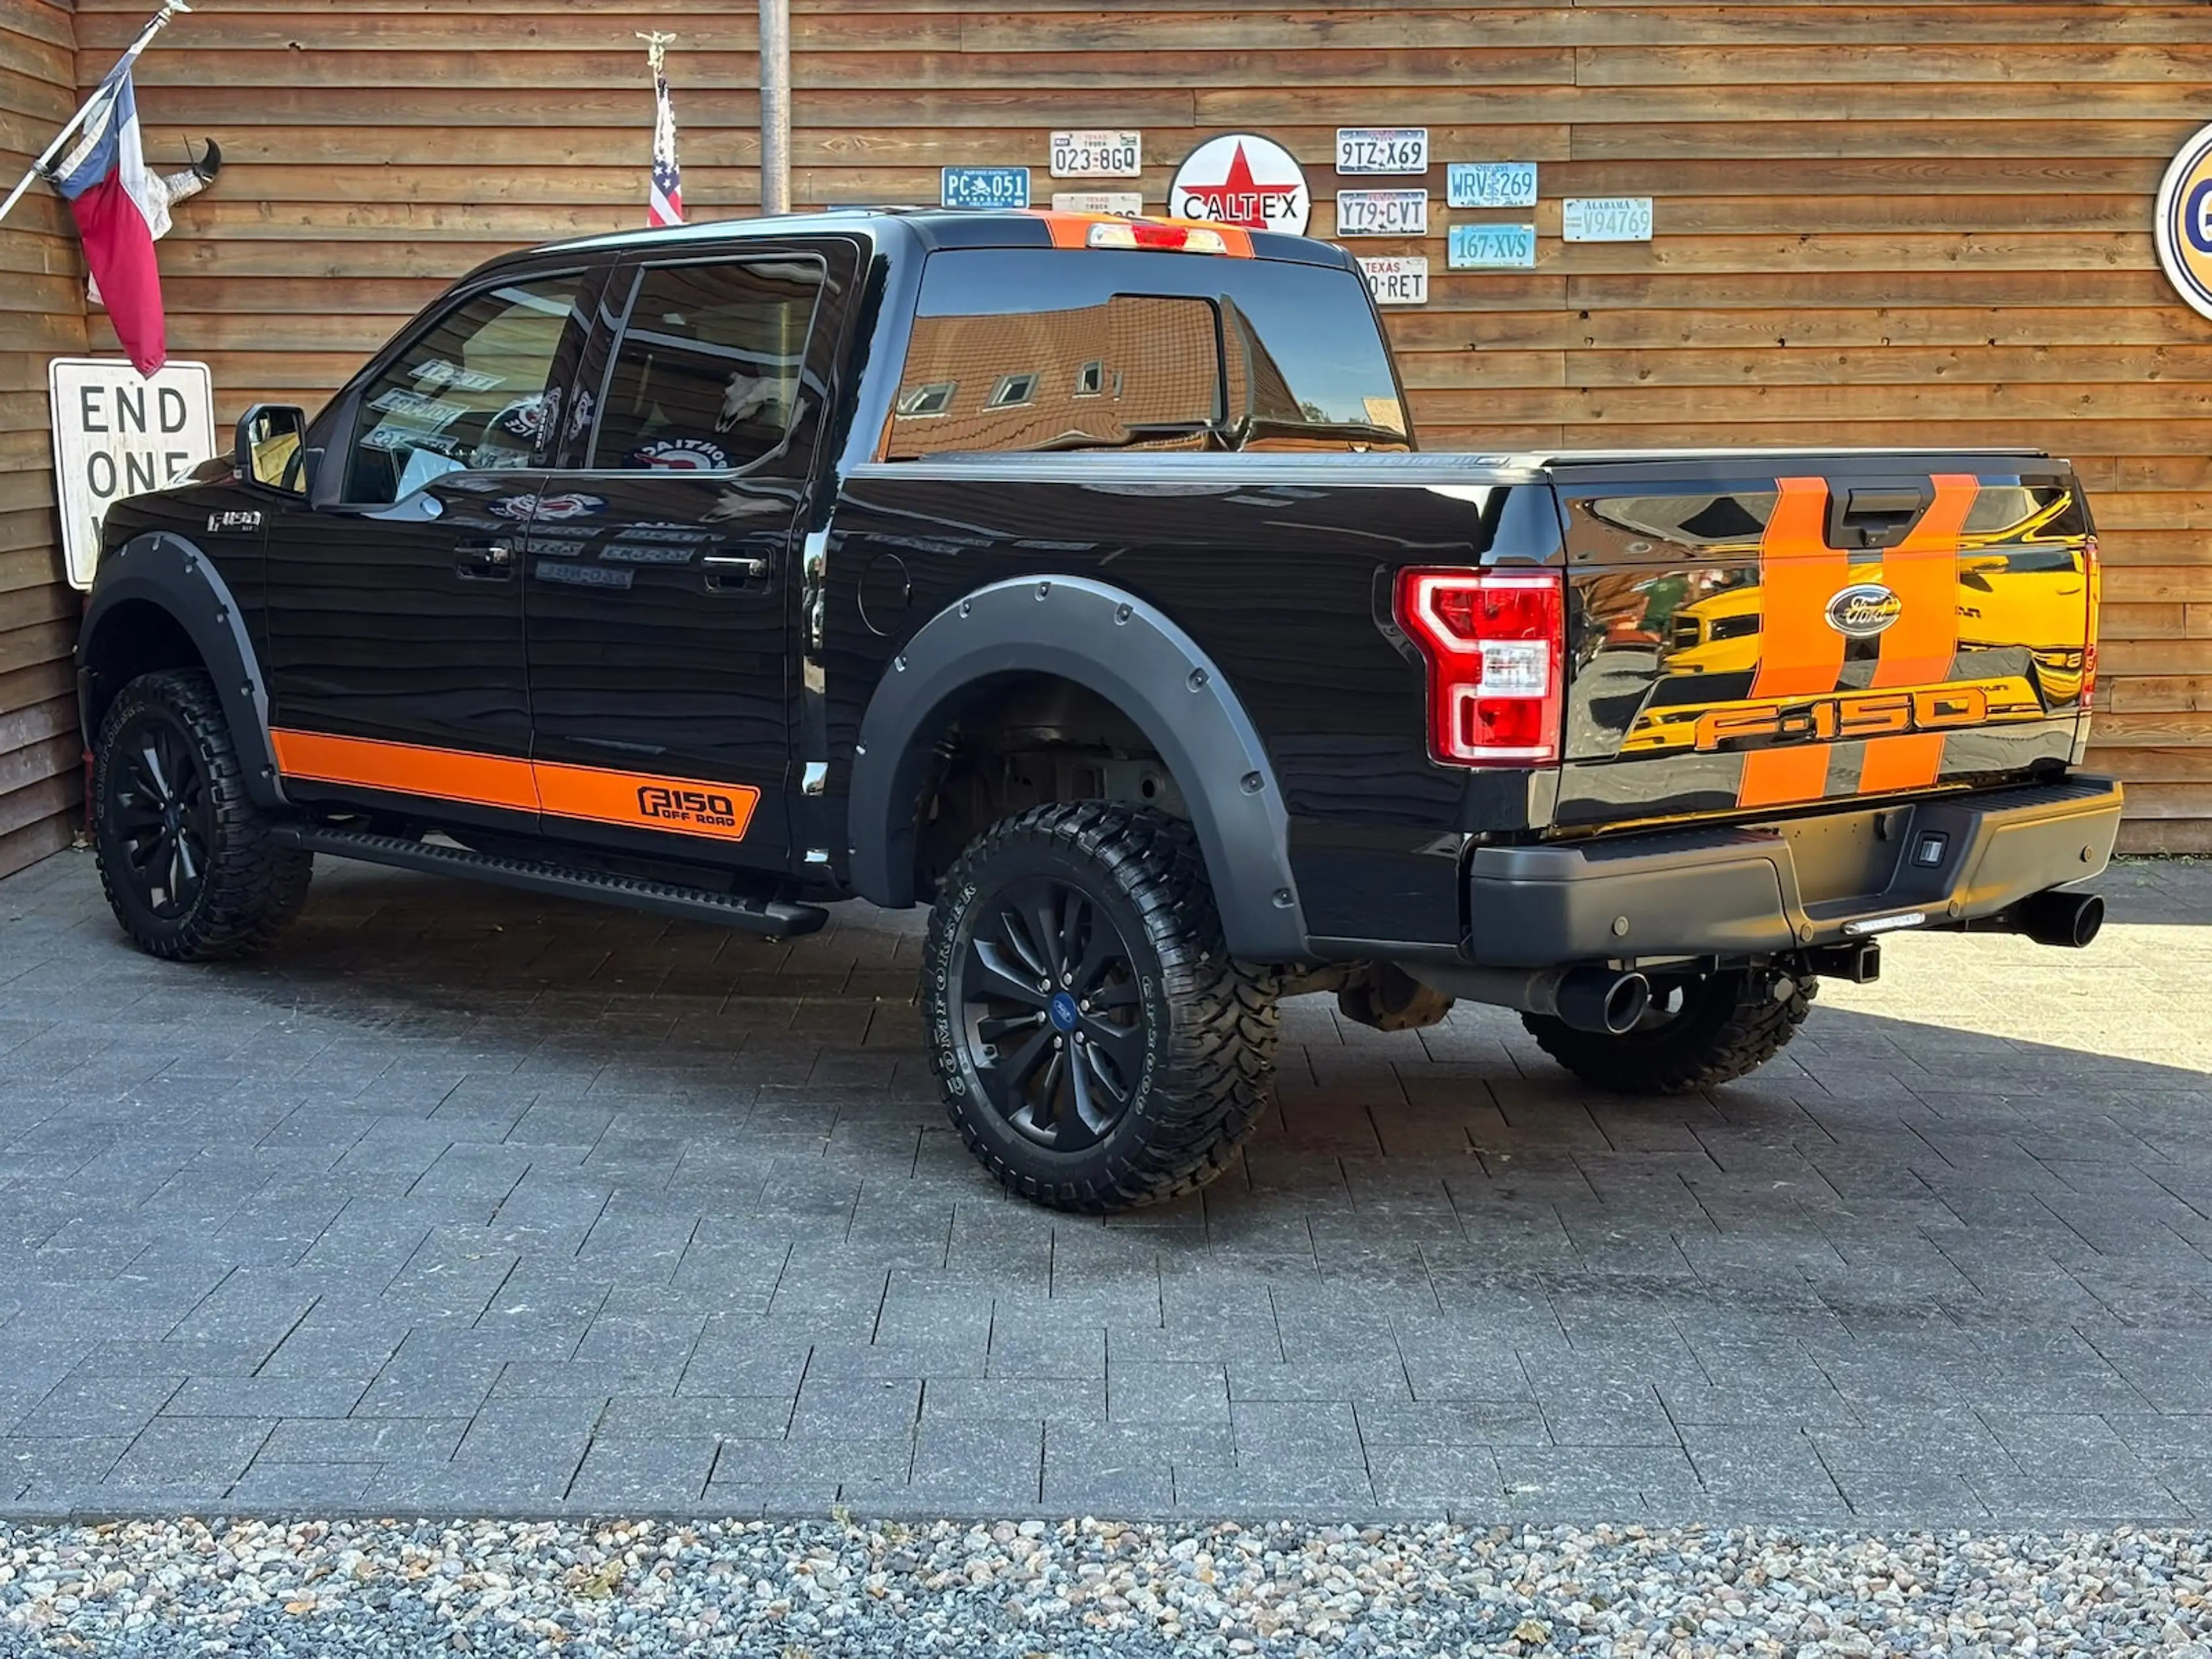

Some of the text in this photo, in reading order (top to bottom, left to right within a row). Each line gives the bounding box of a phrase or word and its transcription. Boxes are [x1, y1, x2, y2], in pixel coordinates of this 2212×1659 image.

[1184, 195, 1298, 220] CALTEX
[1584, 200, 1630, 210] ALABAMA
[1365, 262, 1400, 273] TEXAS
[1388, 274, 1423, 298] RET
[80, 386, 188, 433] END
[1843, 595, 1893, 624] Ford
[1694, 687, 1987, 751] F-150
[662, 809, 736, 827] OFF ROAD
